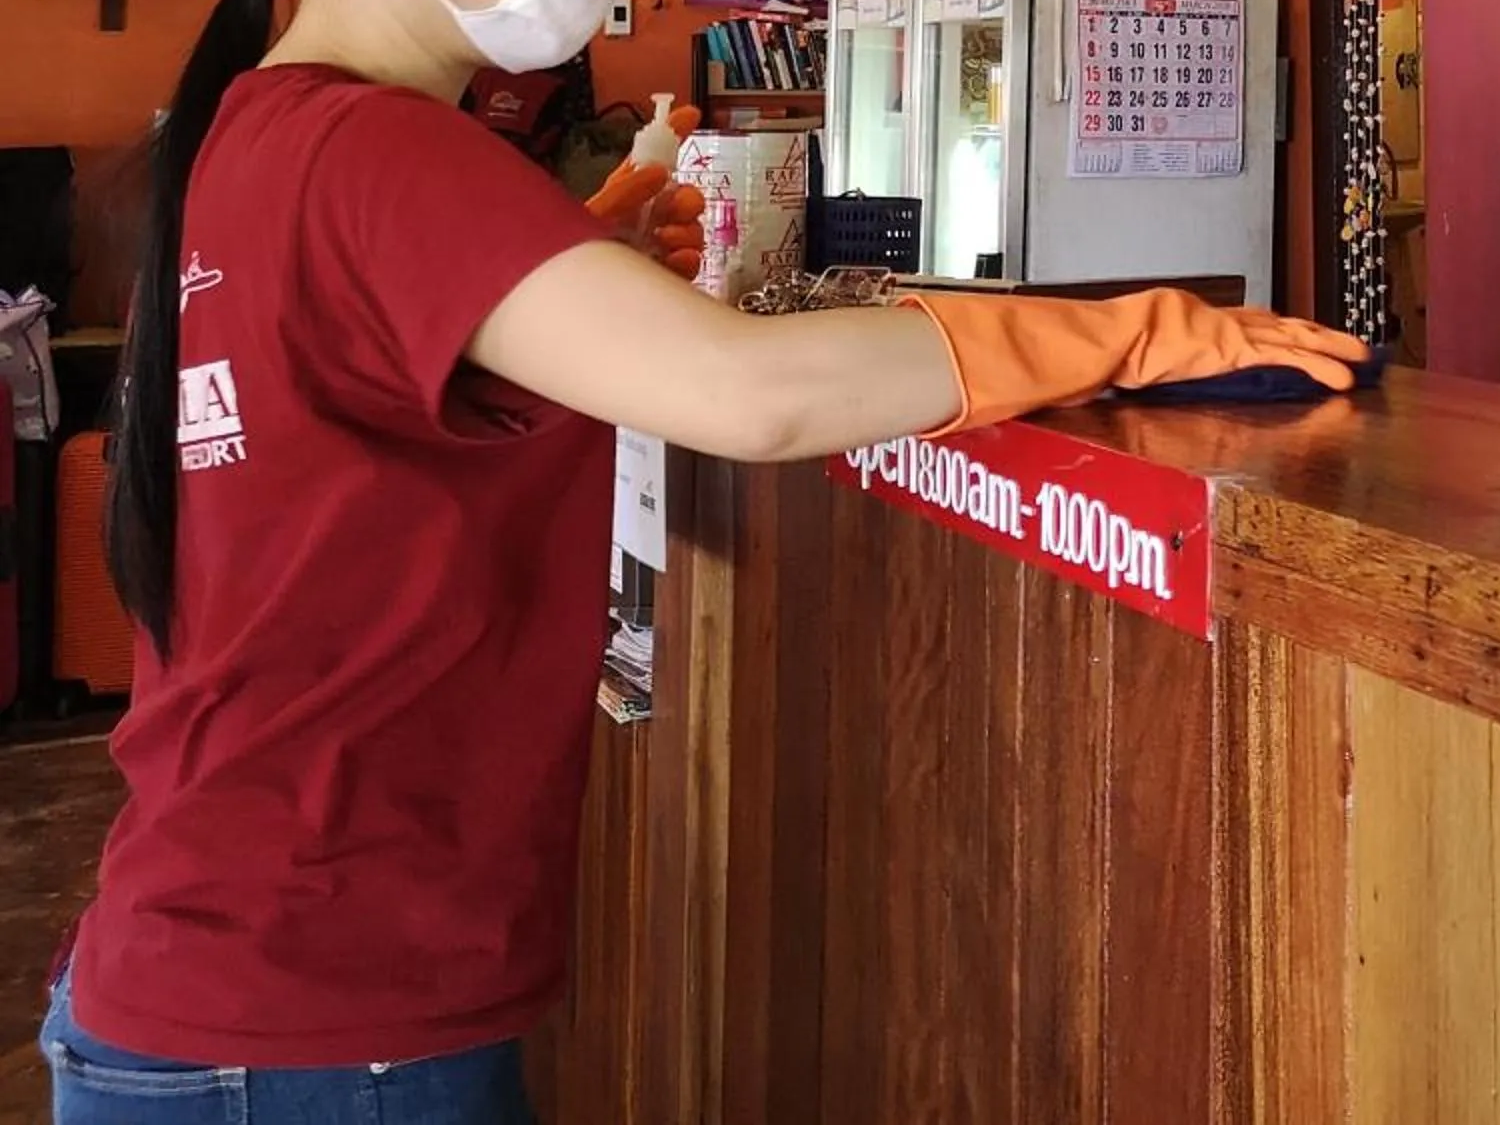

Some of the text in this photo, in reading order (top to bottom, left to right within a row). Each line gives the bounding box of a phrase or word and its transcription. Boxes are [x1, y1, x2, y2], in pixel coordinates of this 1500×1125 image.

[1088, 17, 1231, 37] 1 2 3 4 5 6 7
[1087, 41, 1234, 62] 8 9 10 11 12 13 14
[1086, 65, 1233, 84] 15 16 17 18 19 20 21
[1085, 90, 1234, 108] 22 23 24 25 26 27 28
[1085, 114, 1145, 132] 29 30 31
